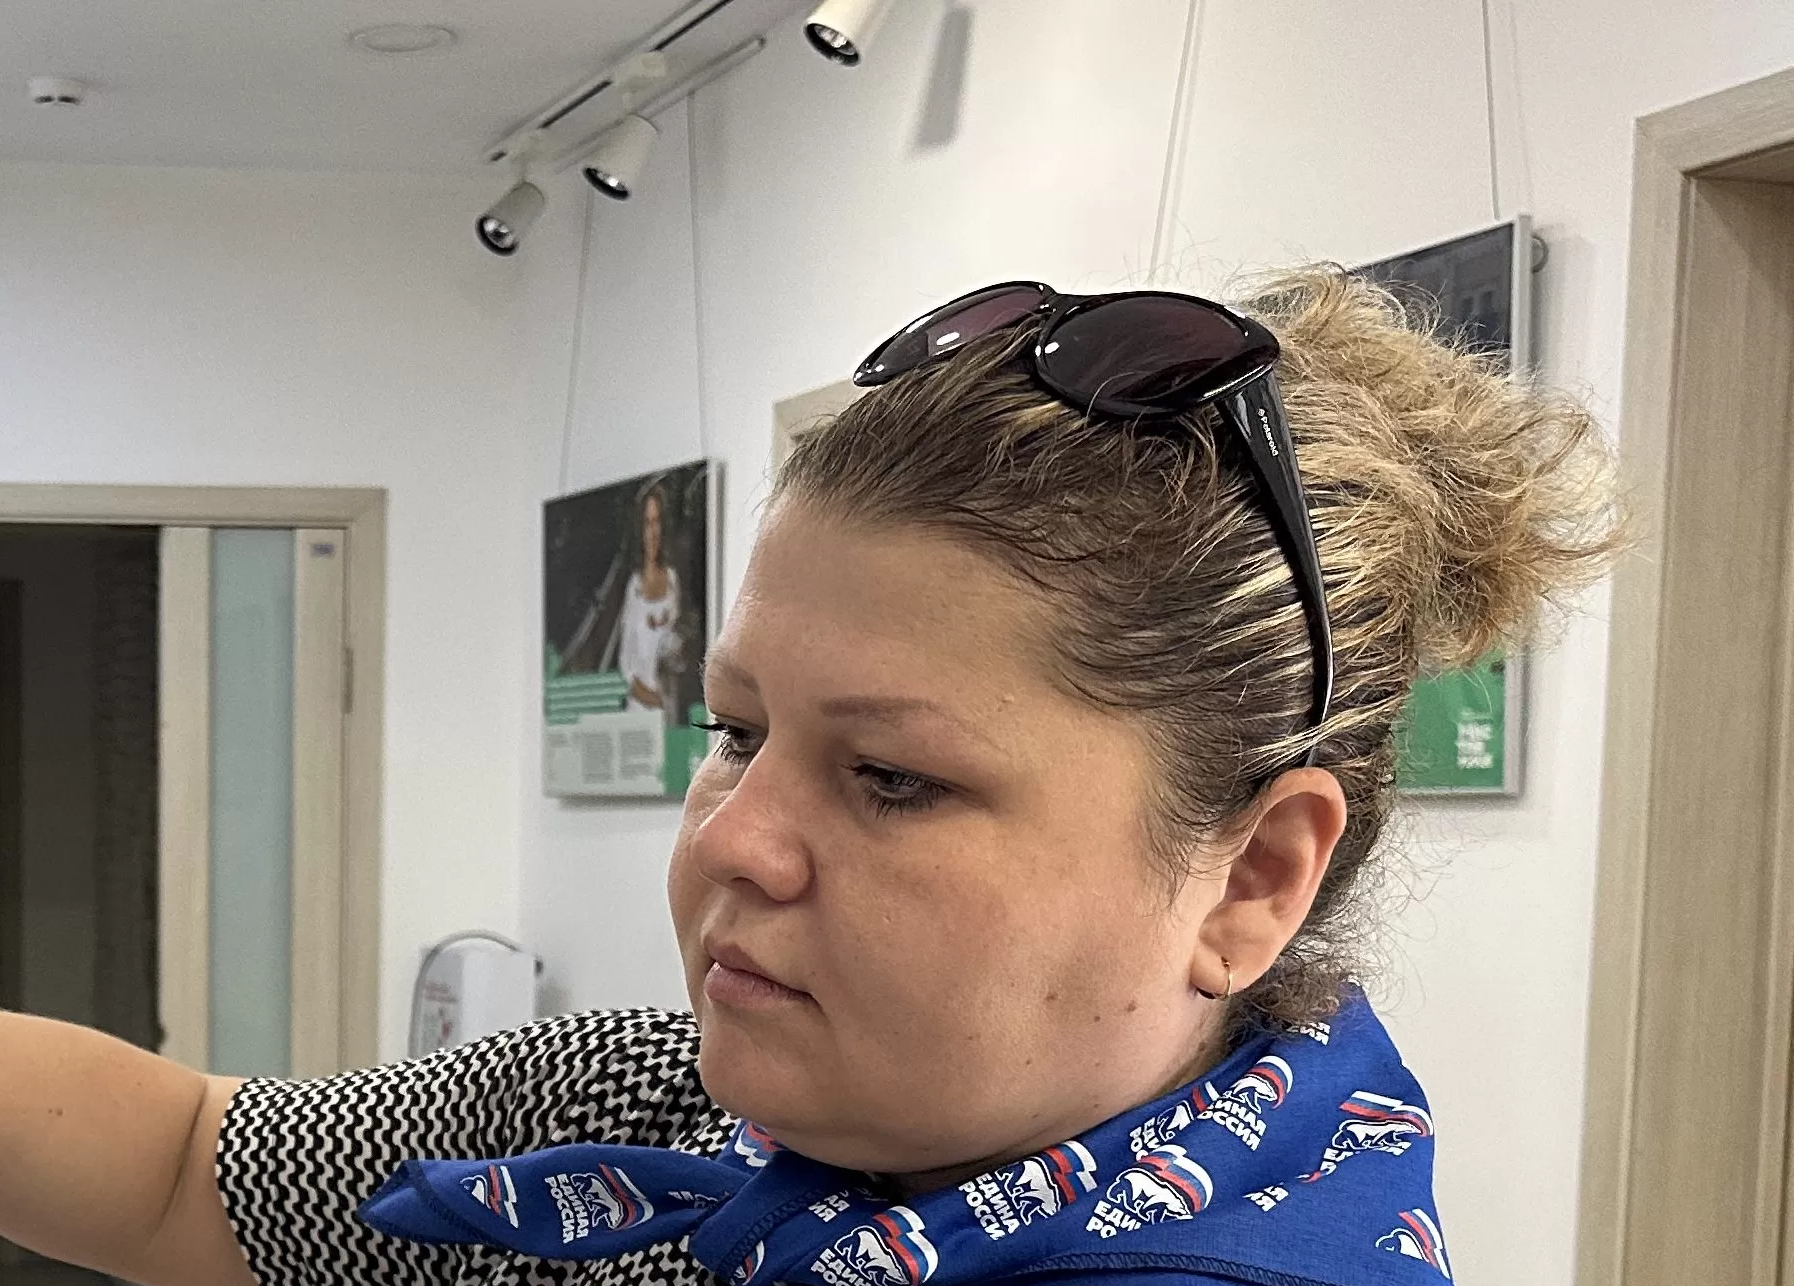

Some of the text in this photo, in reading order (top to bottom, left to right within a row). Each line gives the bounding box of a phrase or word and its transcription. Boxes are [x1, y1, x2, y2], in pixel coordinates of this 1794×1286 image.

[1260, 416, 1279, 457] Polaroid
[1197, 1110, 1261, 1151] ОССИЯ
[1207, 1100, 1267, 1136] ИНАЯ
[544, 1177, 574, 1244] РОССИЯ
[557, 1173, 589, 1238] ЕДИНАЯ
[958, 1181, 1005, 1241] РОССИ
[975, 1172, 1020, 1234] ЕДИНА
